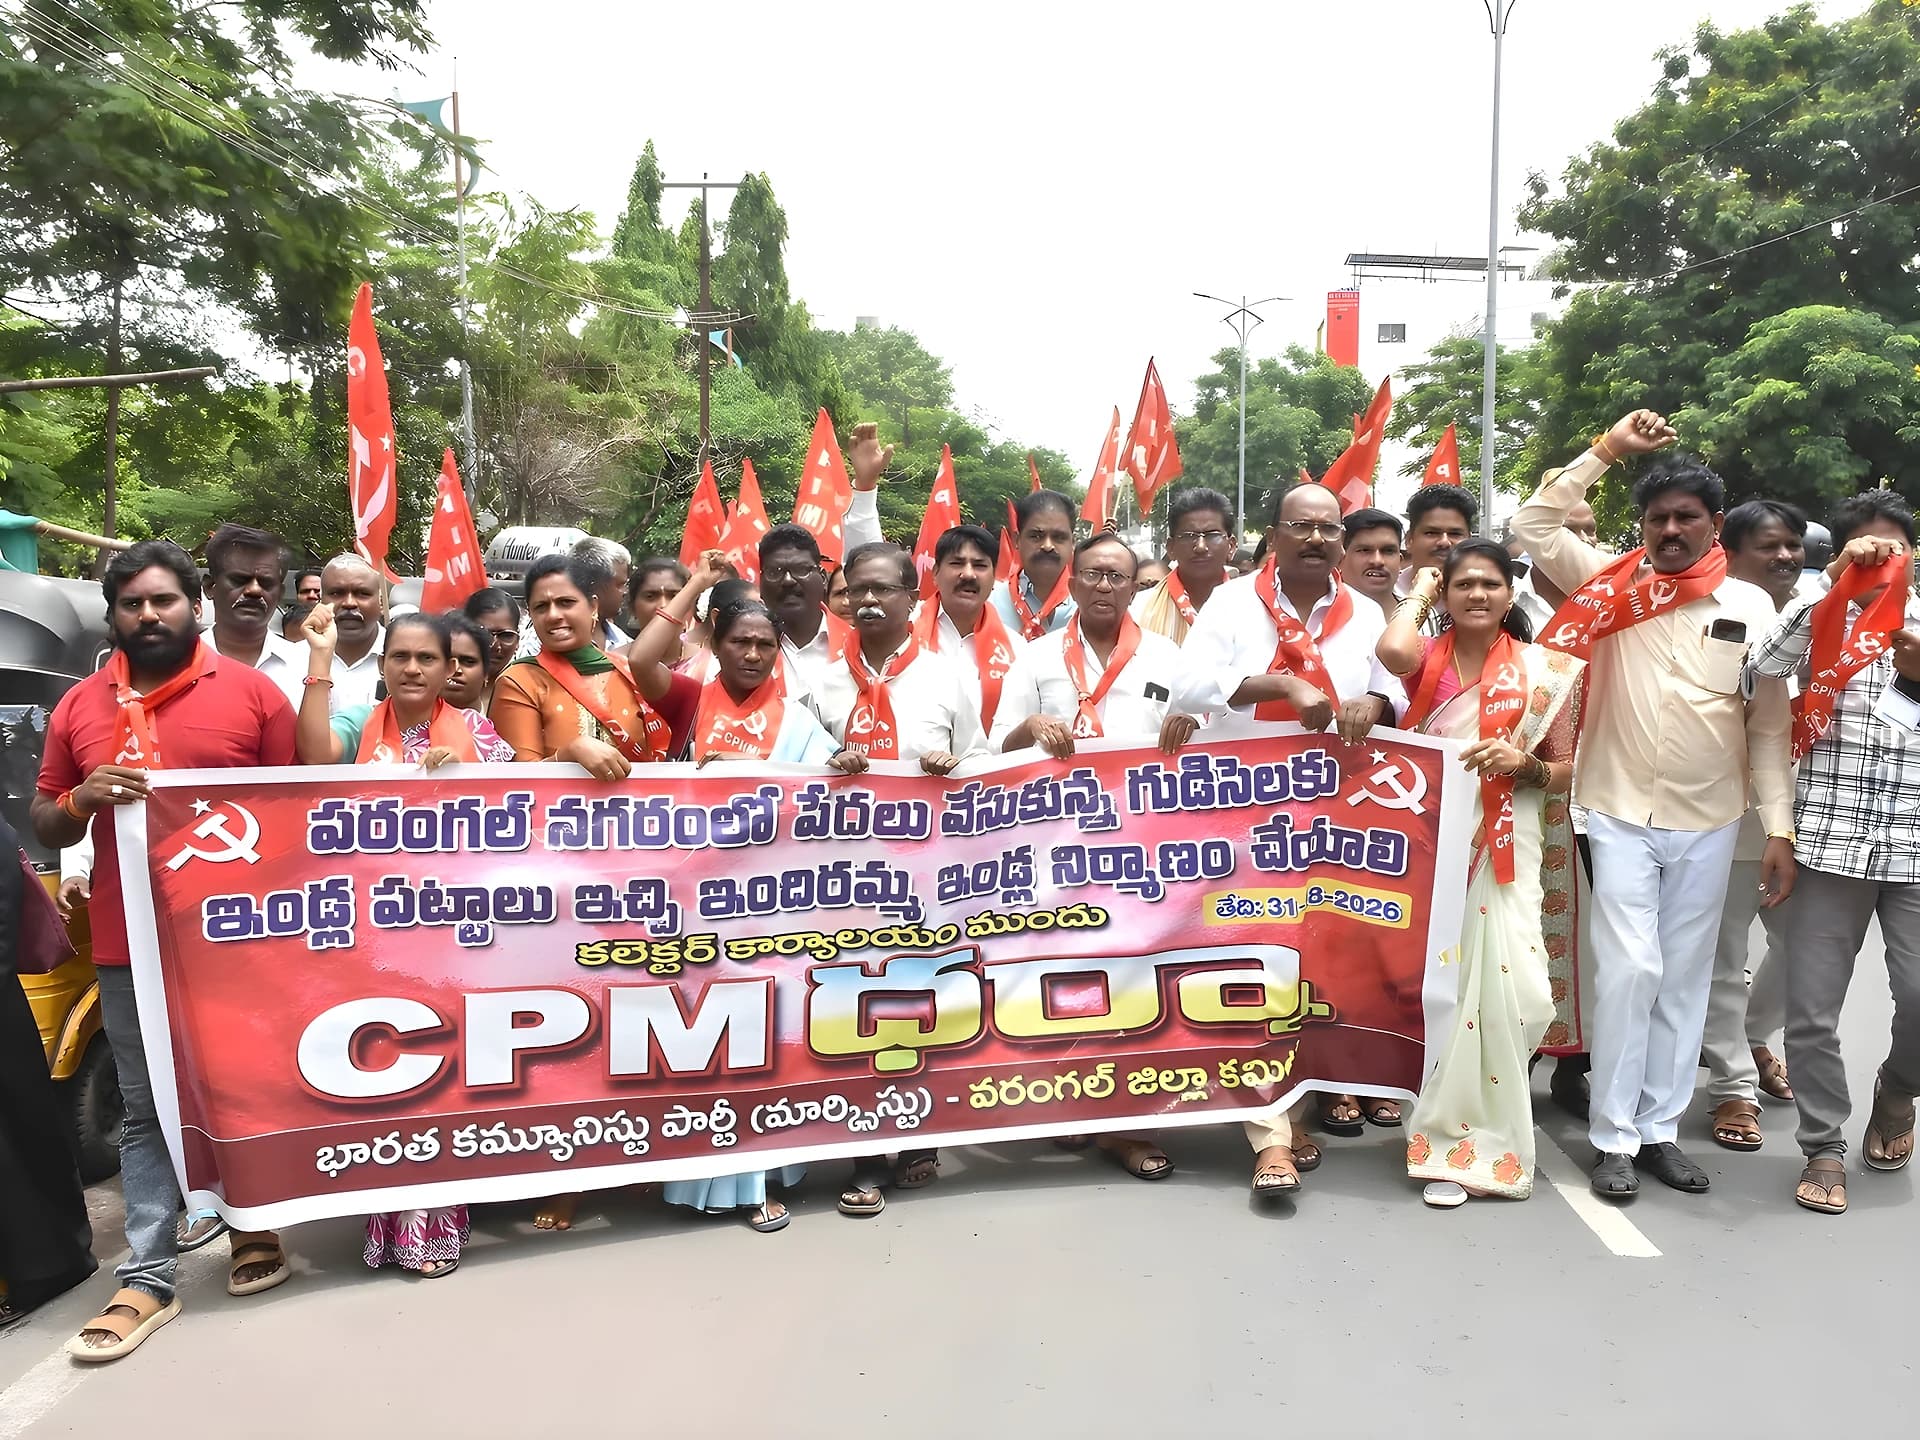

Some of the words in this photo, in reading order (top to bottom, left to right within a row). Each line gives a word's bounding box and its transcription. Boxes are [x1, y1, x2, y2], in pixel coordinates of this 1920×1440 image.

[1627, 588, 1646, 620] PI(M)
[1485, 697, 1523, 716] CPI(M)
[546, 786, 778, 849] నగరంలో
[793, 783, 930, 838] పేదలు
[941, 768, 1117, 833] వేసుకున్న
[1127, 750, 1340, 813] గుడిసెలకు
[203, 875, 353, 949] ఇండ్ల
[371, 875, 557, 947] పట్టాలు
[575, 877, 679, 936] ఇచ్చి
[698, 859, 923, 923] ఇందిరమ్మ
[936, 844, 1037, 906] ఇండ్ల
[1051, 839, 1235, 901] నిర్మాణం
[1250, 814, 1409, 876] చేయాలి
[1267, 886, 1403, 922] 31-8-2026
[576, 933, 717, 973] కలెక్టర్
[726, 922, 960, 961] కార్యాలయం
[966, 902, 1107, 938] ముందు
[296, 979, 771, 1099] CPM
[315, 1127, 441, 1178] భారత
[451, 1109, 650, 1163] కమ్యూనిస్టు
[661, 1098, 738, 1148] పార్టీ
[968, 1063, 1116, 1110] వరంగల్
[1126, 1066, 1208, 1103] జిల్లా
